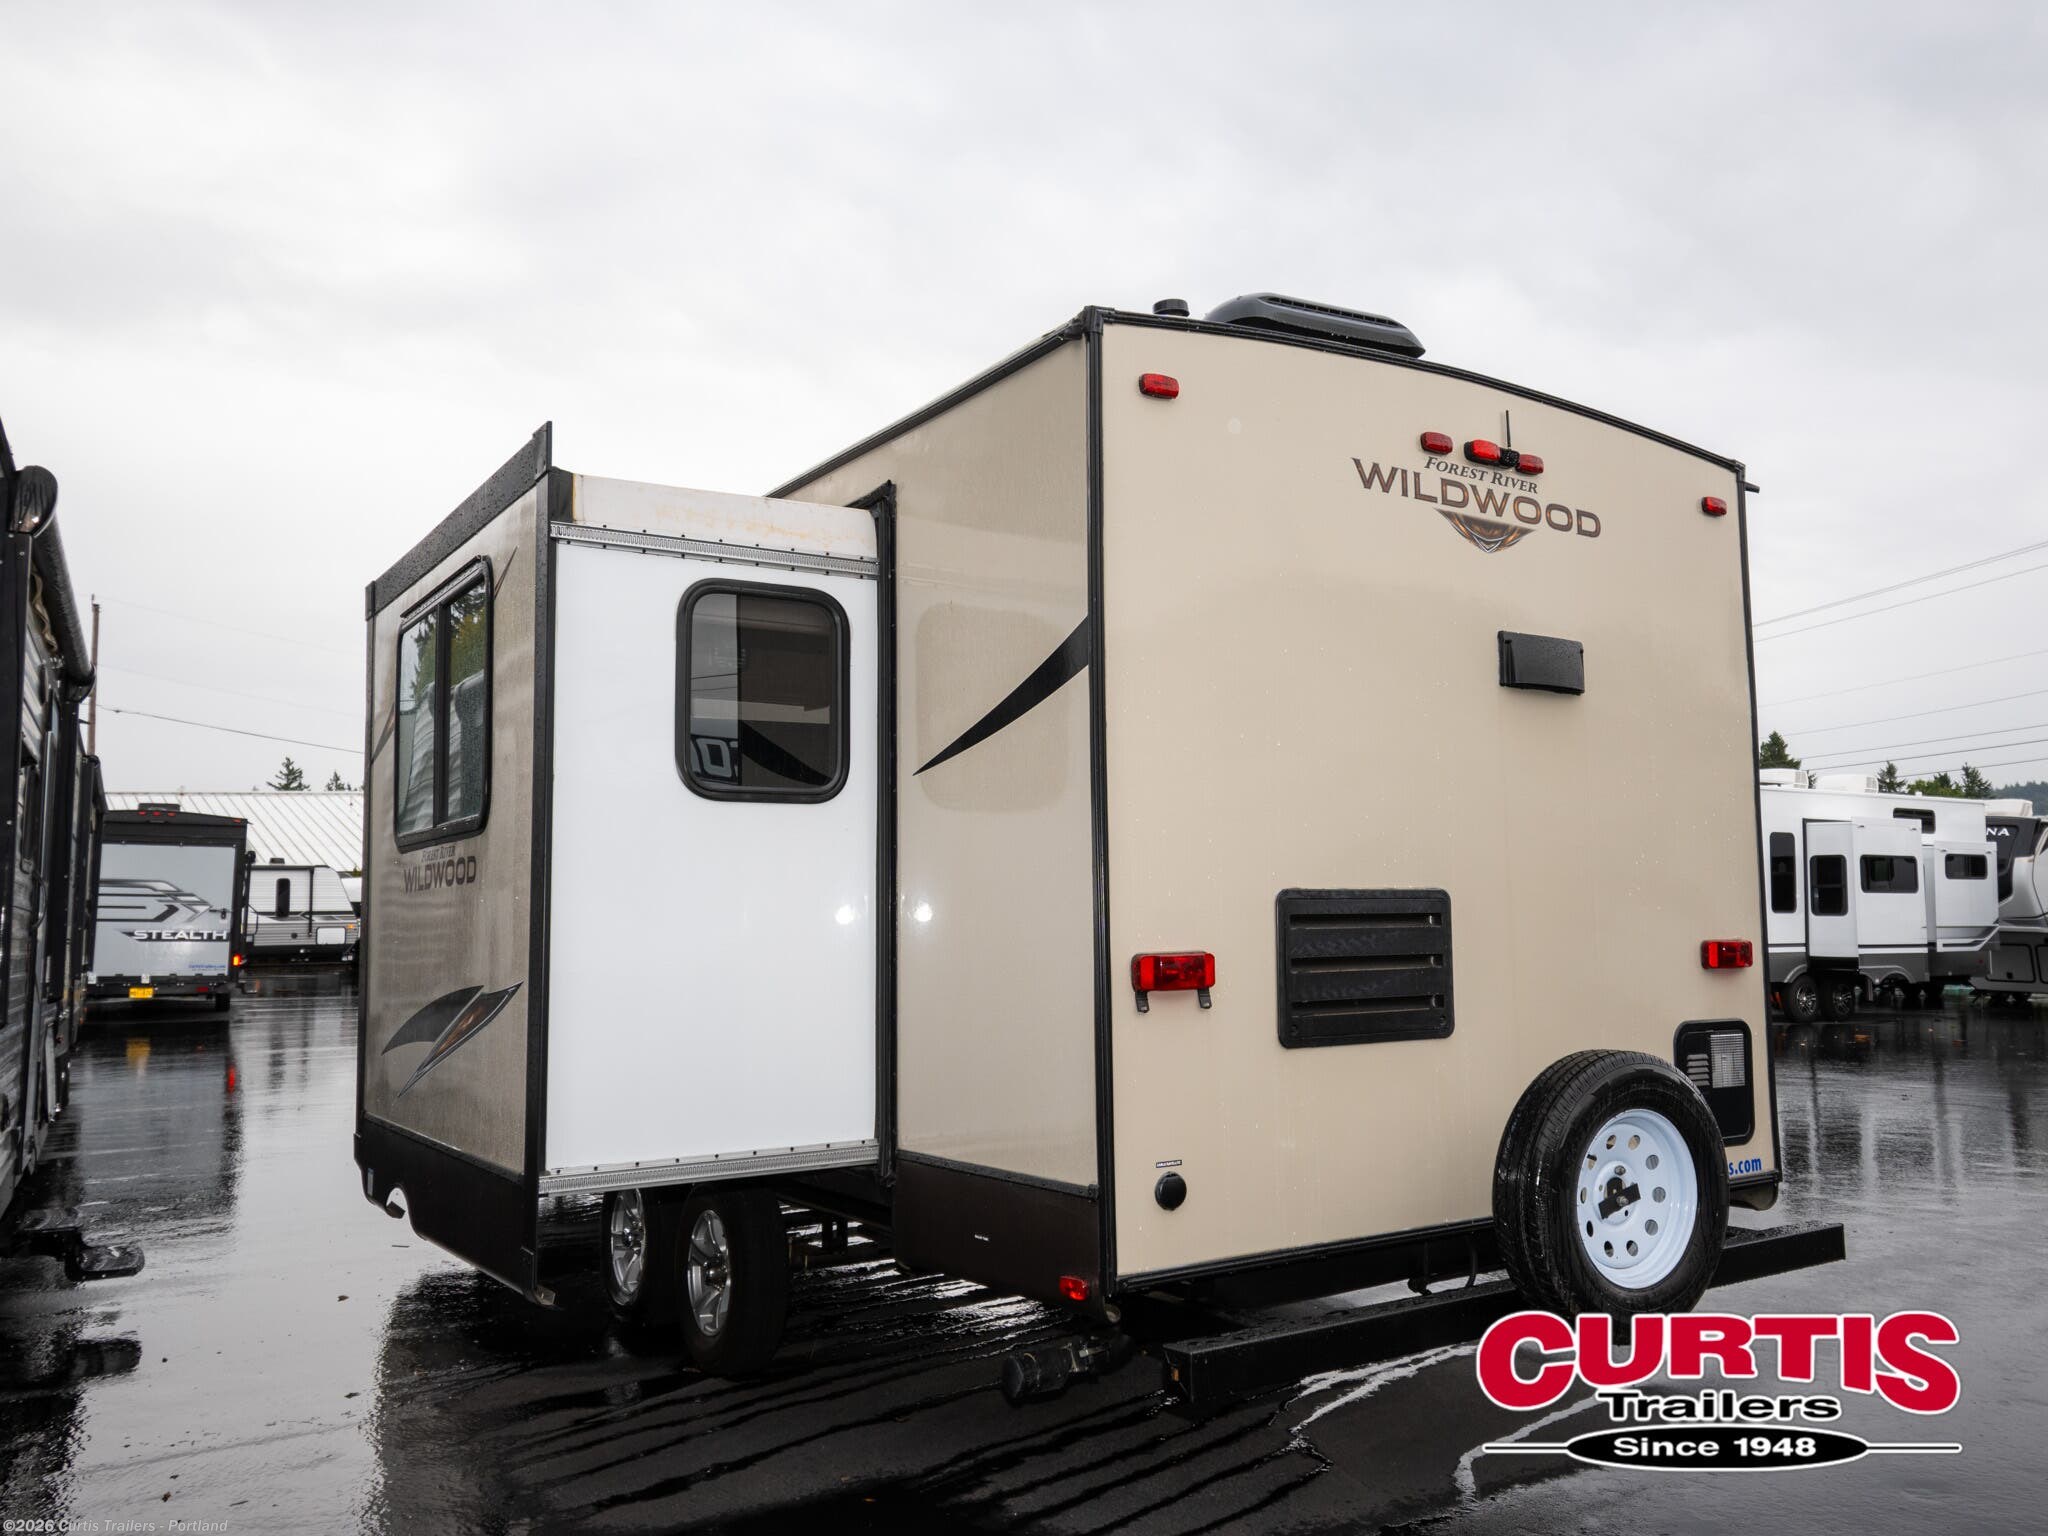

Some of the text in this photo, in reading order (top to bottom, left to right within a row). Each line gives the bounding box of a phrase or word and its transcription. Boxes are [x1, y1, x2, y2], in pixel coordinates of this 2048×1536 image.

[1423, 456, 1539, 495] FOREST RIVER
[1351, 457, 1602, 538] WILDWOOD
[403, 855, 477, 894] WILDWOOD
[133, 929, 228, 940] STEALTH
